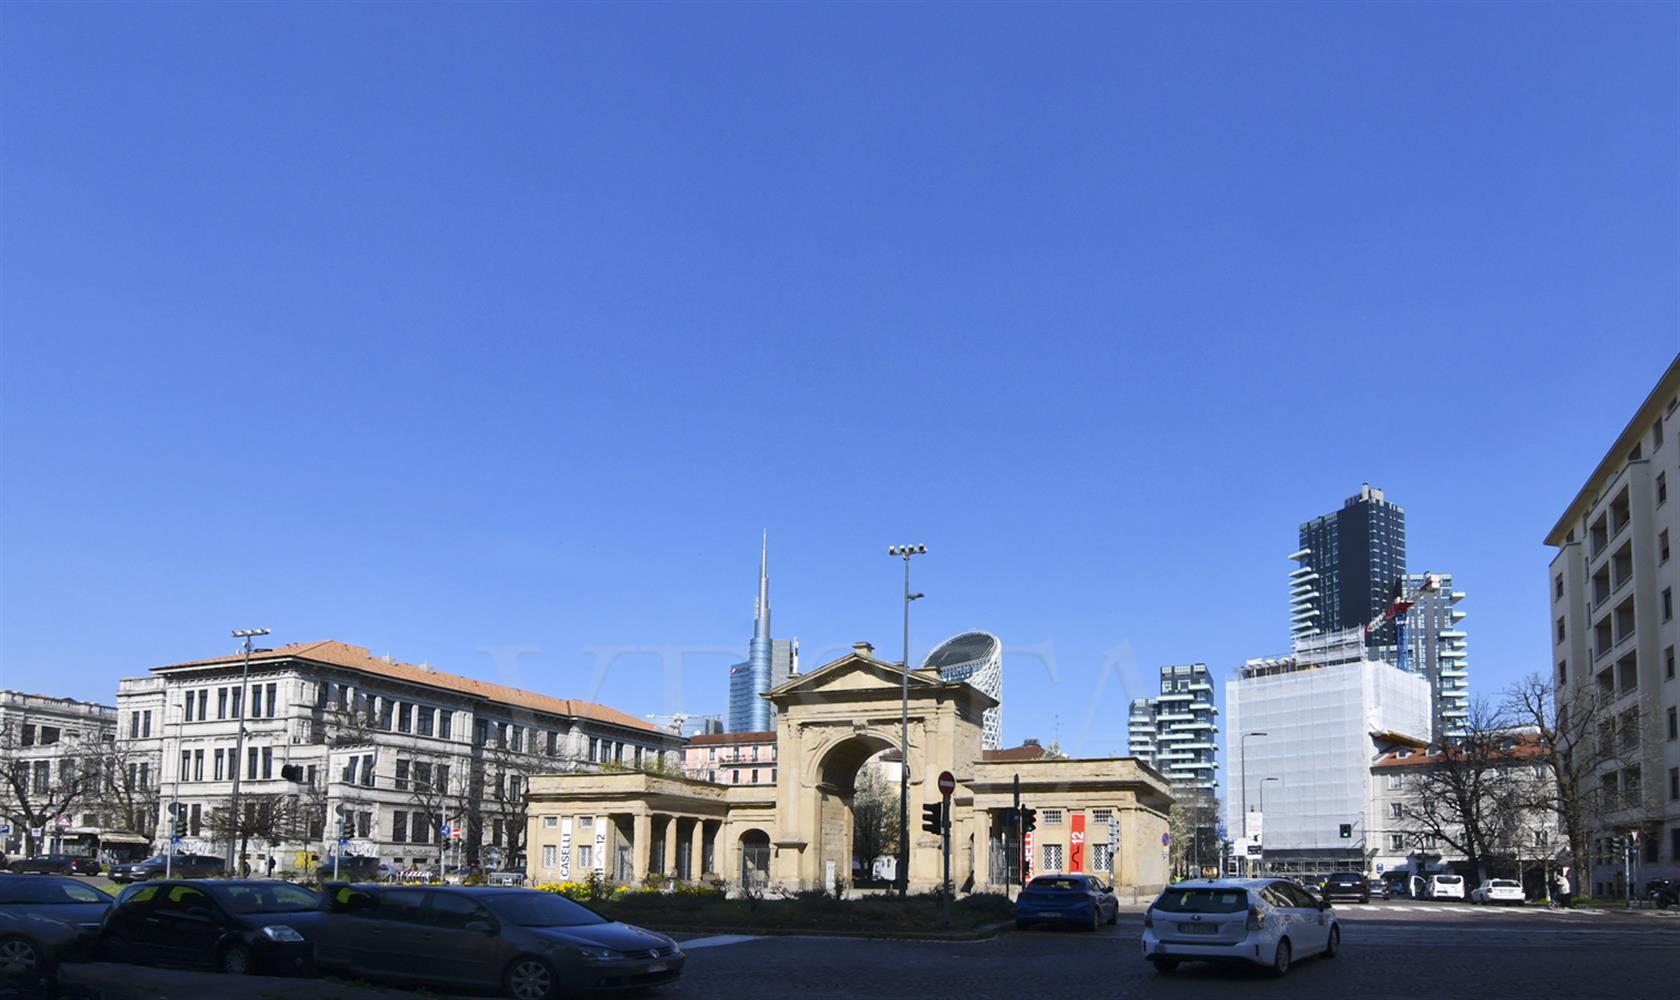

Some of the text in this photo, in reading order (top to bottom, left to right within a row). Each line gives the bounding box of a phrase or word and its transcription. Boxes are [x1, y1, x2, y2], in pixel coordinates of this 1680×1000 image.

[597, 834, 605, 844] 12
[1072, 832, 1084, 844] 12
[561, 833, 570, 876] CASELLI
